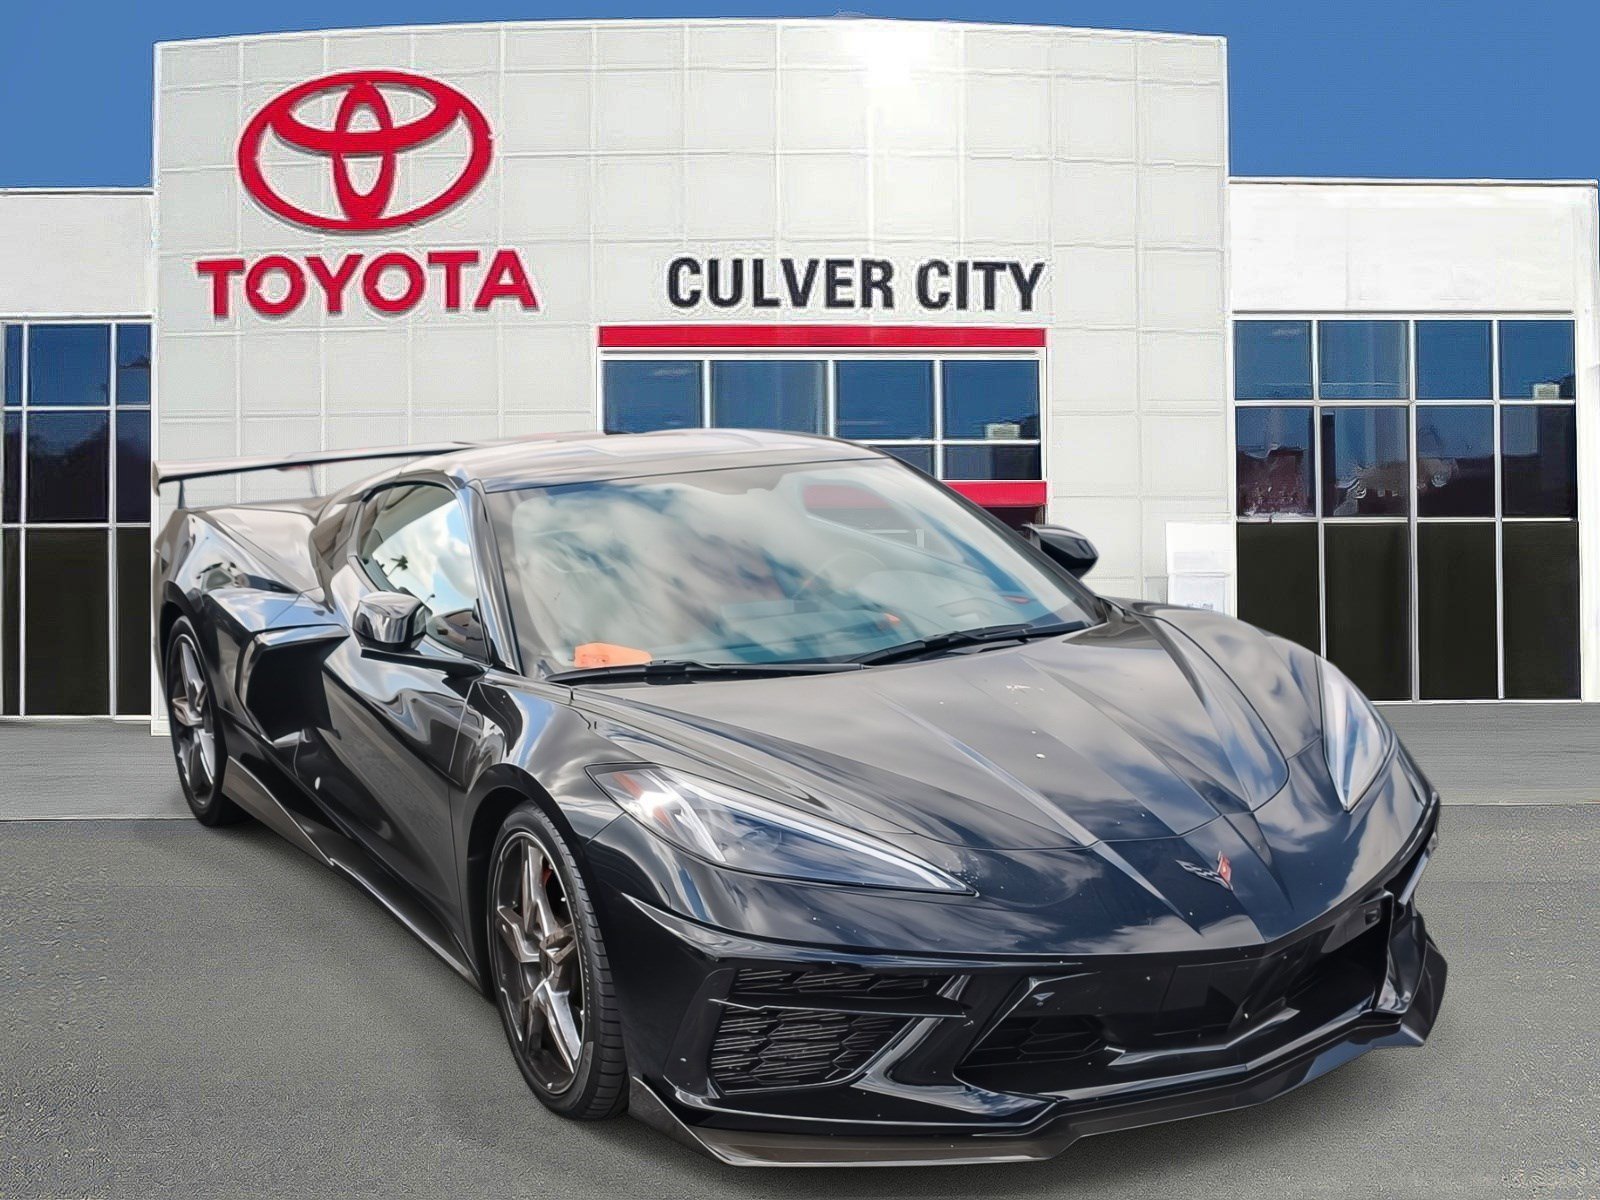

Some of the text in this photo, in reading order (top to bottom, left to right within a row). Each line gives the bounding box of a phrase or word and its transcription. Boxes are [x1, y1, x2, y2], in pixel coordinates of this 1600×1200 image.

[196, 250, 537, 317] TOYOTA
[668, 257, 1045, 311] CULVER CITY
